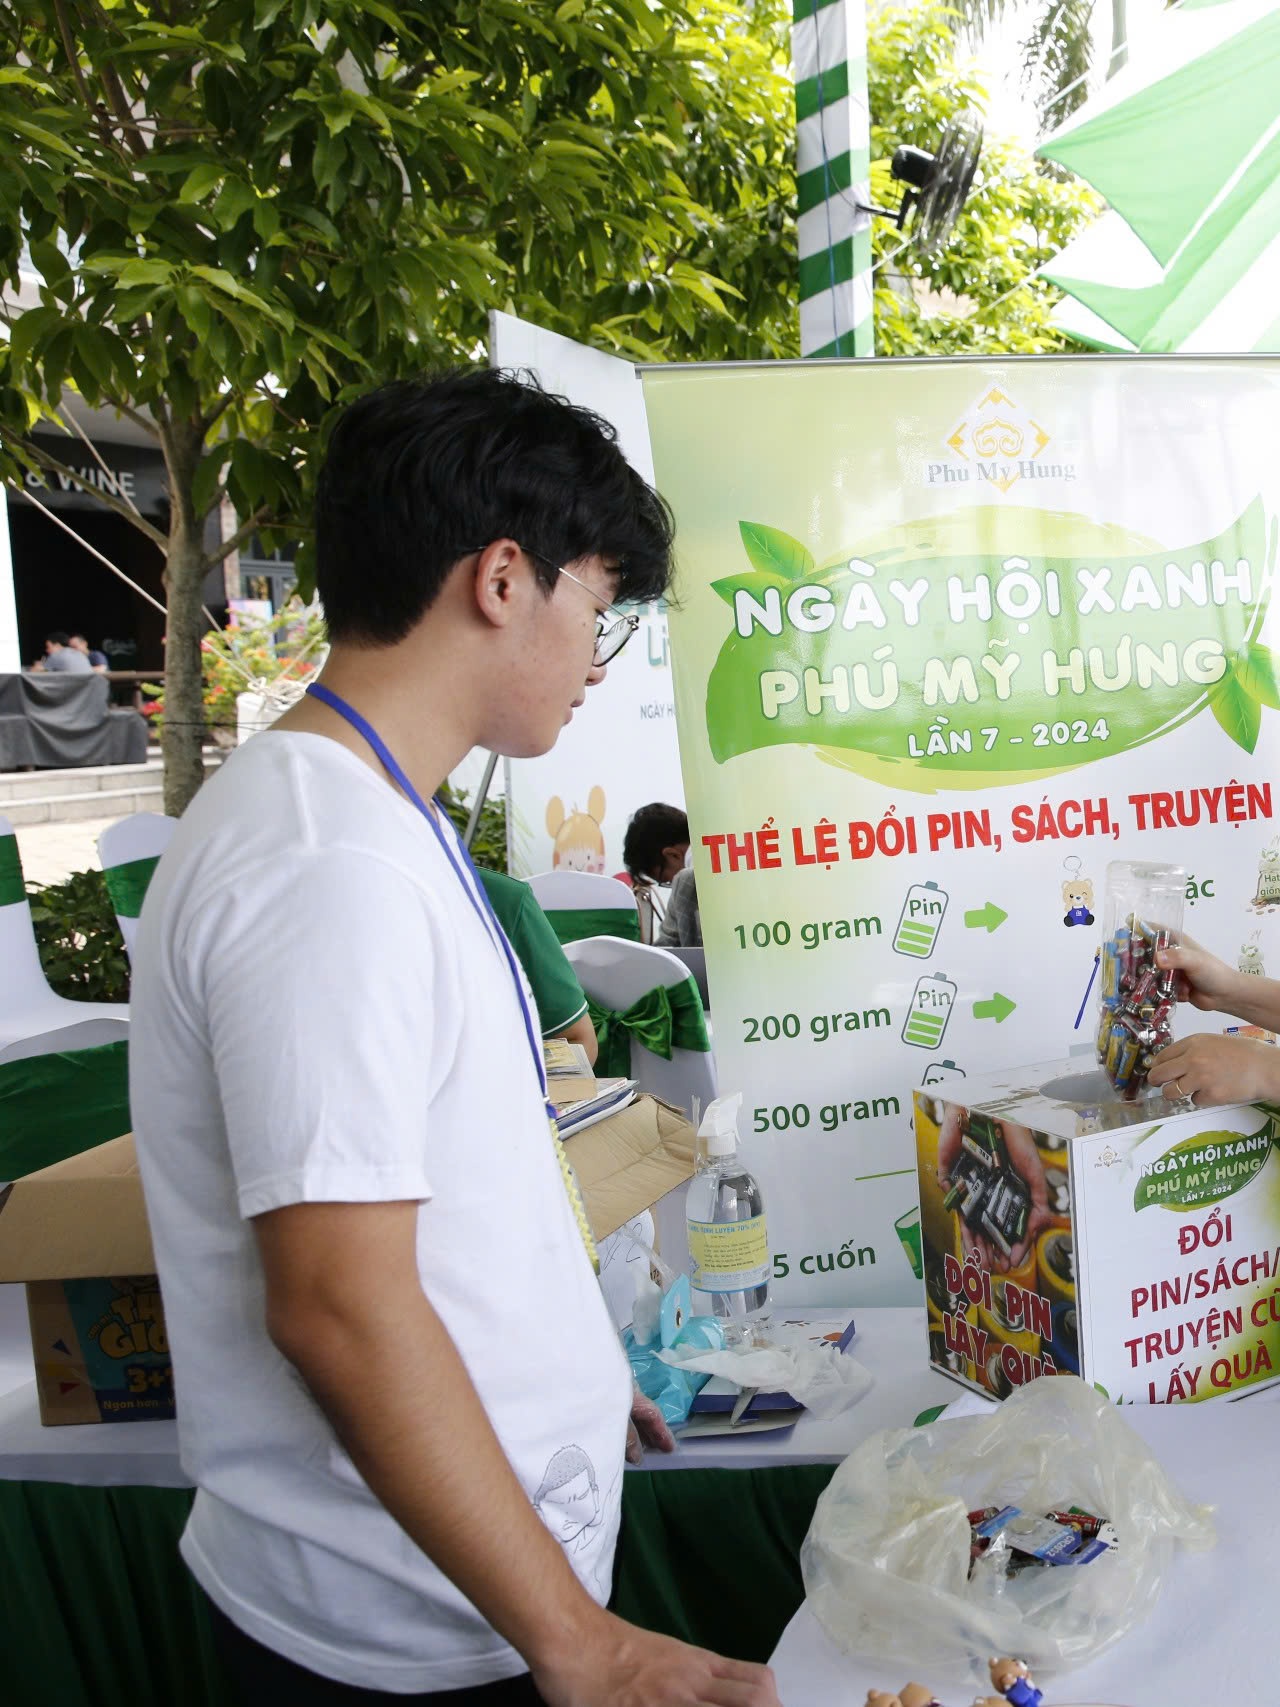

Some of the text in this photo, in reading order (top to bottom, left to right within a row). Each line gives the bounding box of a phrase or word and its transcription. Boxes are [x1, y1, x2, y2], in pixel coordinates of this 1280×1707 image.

[57, 464, 137, 498] WINE
[927, 460, 1077, 484] Phu My Hung
[733, 555, 1253, 638] NGÀY HỘI XANH
[759, 633, 1228, 721] PHÚ MỸ HƯNG
[907, 714, 972, 758] LẦN
[980, 726, 999, 752] 7
[1032, 717, 1111, 748] 2024
[702, 816, 783, 873] THỂ
[791, 817, 840, 870] LỆ
[848, 804, 918, 860] ĐỔI
[927, 808, 1002, 853] PIN,
[1010, 795, 1120, 843] SÁCH,
[1128, 779, 1273, 831] TRUYỆN
[909, 898, 943, 918] Pin
[733, 915, 883, 951] 100 gram
[918, 988, 951, 1009] Pin
[742, 1006, 892, 1043] 200 gram
[753, 1096, 901, 1133] 500 gram
[1140, 1135, 1269, 1178] NGÀY HỘI XANH
[1146, 1158, 1262, 1199] PHÚ MỸ HƯNG
[1181, 1188, 1198, 1204] LẦN
[1199, 1189, 1205, 1200] 7
[1212, 1184, 1233, 1196] 2024
[1177, 1206, 1233, 1256] ĐỔI
[773, 1253, 790, 1279] 5
[799, 1239, 877, 1276] cuốn
[944, 1246, 1054, 1343] ĐỔI PIN
[943, 1300, 989, 1369] LẤY
[1124, 1306, 1244, 1369] TRUYỆN
[1148, 1339, 1273, 1405] LẤY QUÀ
